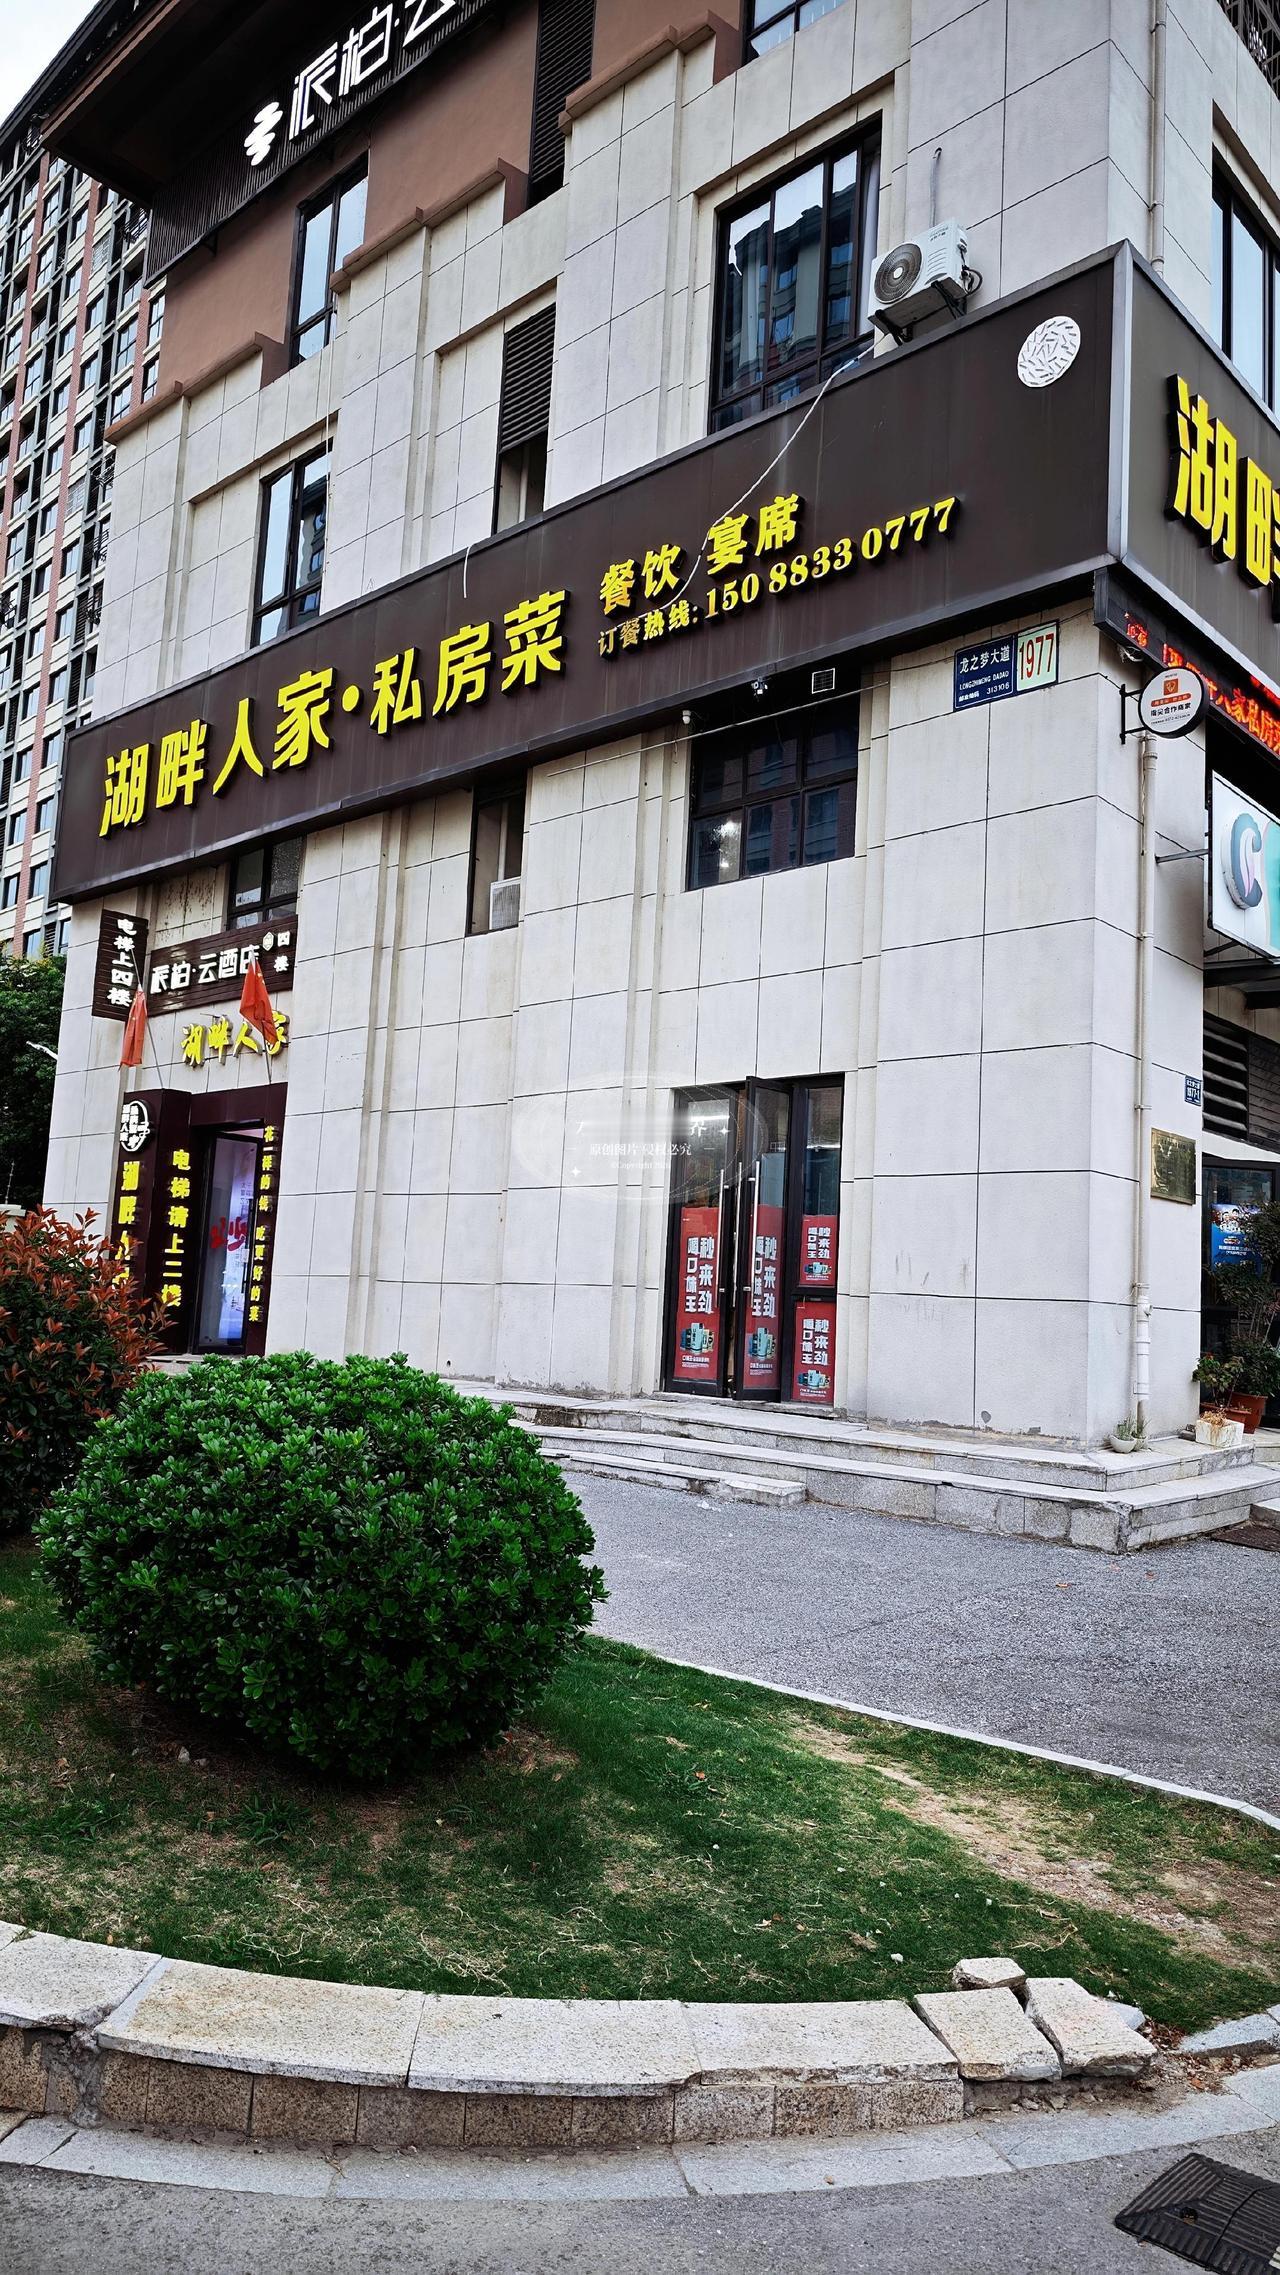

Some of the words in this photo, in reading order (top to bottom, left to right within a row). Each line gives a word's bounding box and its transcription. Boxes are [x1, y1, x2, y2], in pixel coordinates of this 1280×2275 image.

[599, 543, 682, 615] 餐饮
[705, 492, 800, 576] 宴席
[704, 572, 761, 620] 150
[768, 536, 853, 594] 8833
[860, 497, 956, 560] 0777
[959, 645, 1010, 674] 龙之梦大道
[986, 682, 1010, 695] 313106
[992, 670, 1010, 682] DADAO
[1018, 632, 1055, 681] 1977
[99, 589, 568, 838] 湖畔人家·私房菜
[106, 918, 138, 1008] 电梯上四楼
[273, 930, 291, 973] 四楼
[161, 1149, 191, 1307] 电梯请上二楼
